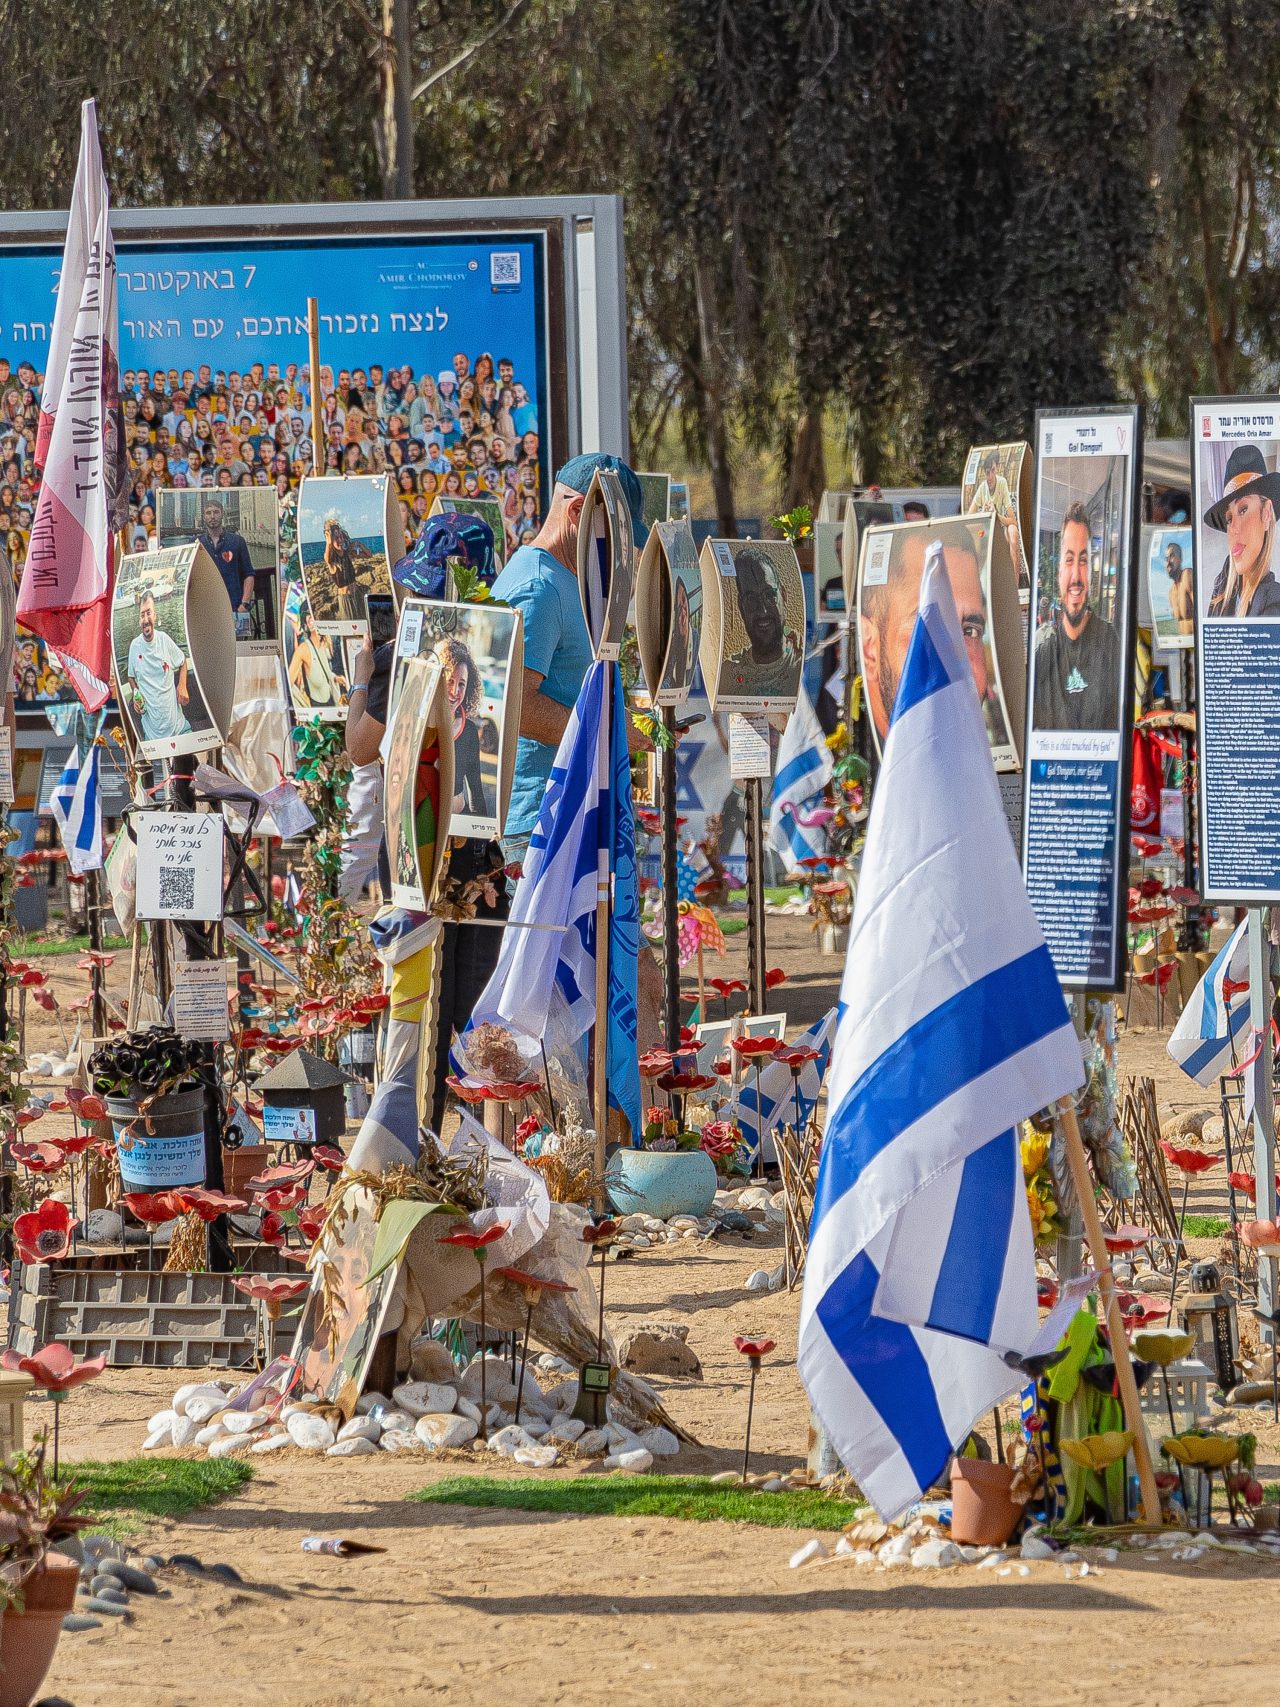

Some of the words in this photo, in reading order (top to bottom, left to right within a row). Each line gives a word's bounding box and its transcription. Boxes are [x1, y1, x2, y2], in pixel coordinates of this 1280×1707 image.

[119, 267, 235, 296] באוקטובר
[242, 265, 256, 288] 7
[408, 272, 468, 283] CHODOROV
[320, 314, 379, 334] נזכור
[390, 305, 449, 332] לנצח
[123, 319, 181, 340] האור
[193, 319, 223, 339] עם
[235, 315, 310, 340] אתכם,
[1221, 430, 1246, 438] Mercedes
[1247, 430, 1258, 438] Oria
[1068, 442, 1078, 453] Gal
[1080, 442, 1103, 454] Danguri
[149, 823, 178, 834] מישהו
[180, 824, 195, 834] עוד
[197, 818, 209, 835] כל
[155, 836, 178, 849] אותי
[180, 840, 202, 849] זוכר
[165, 854, 174, 862] חי
[177, 850, 193, 864] אני
